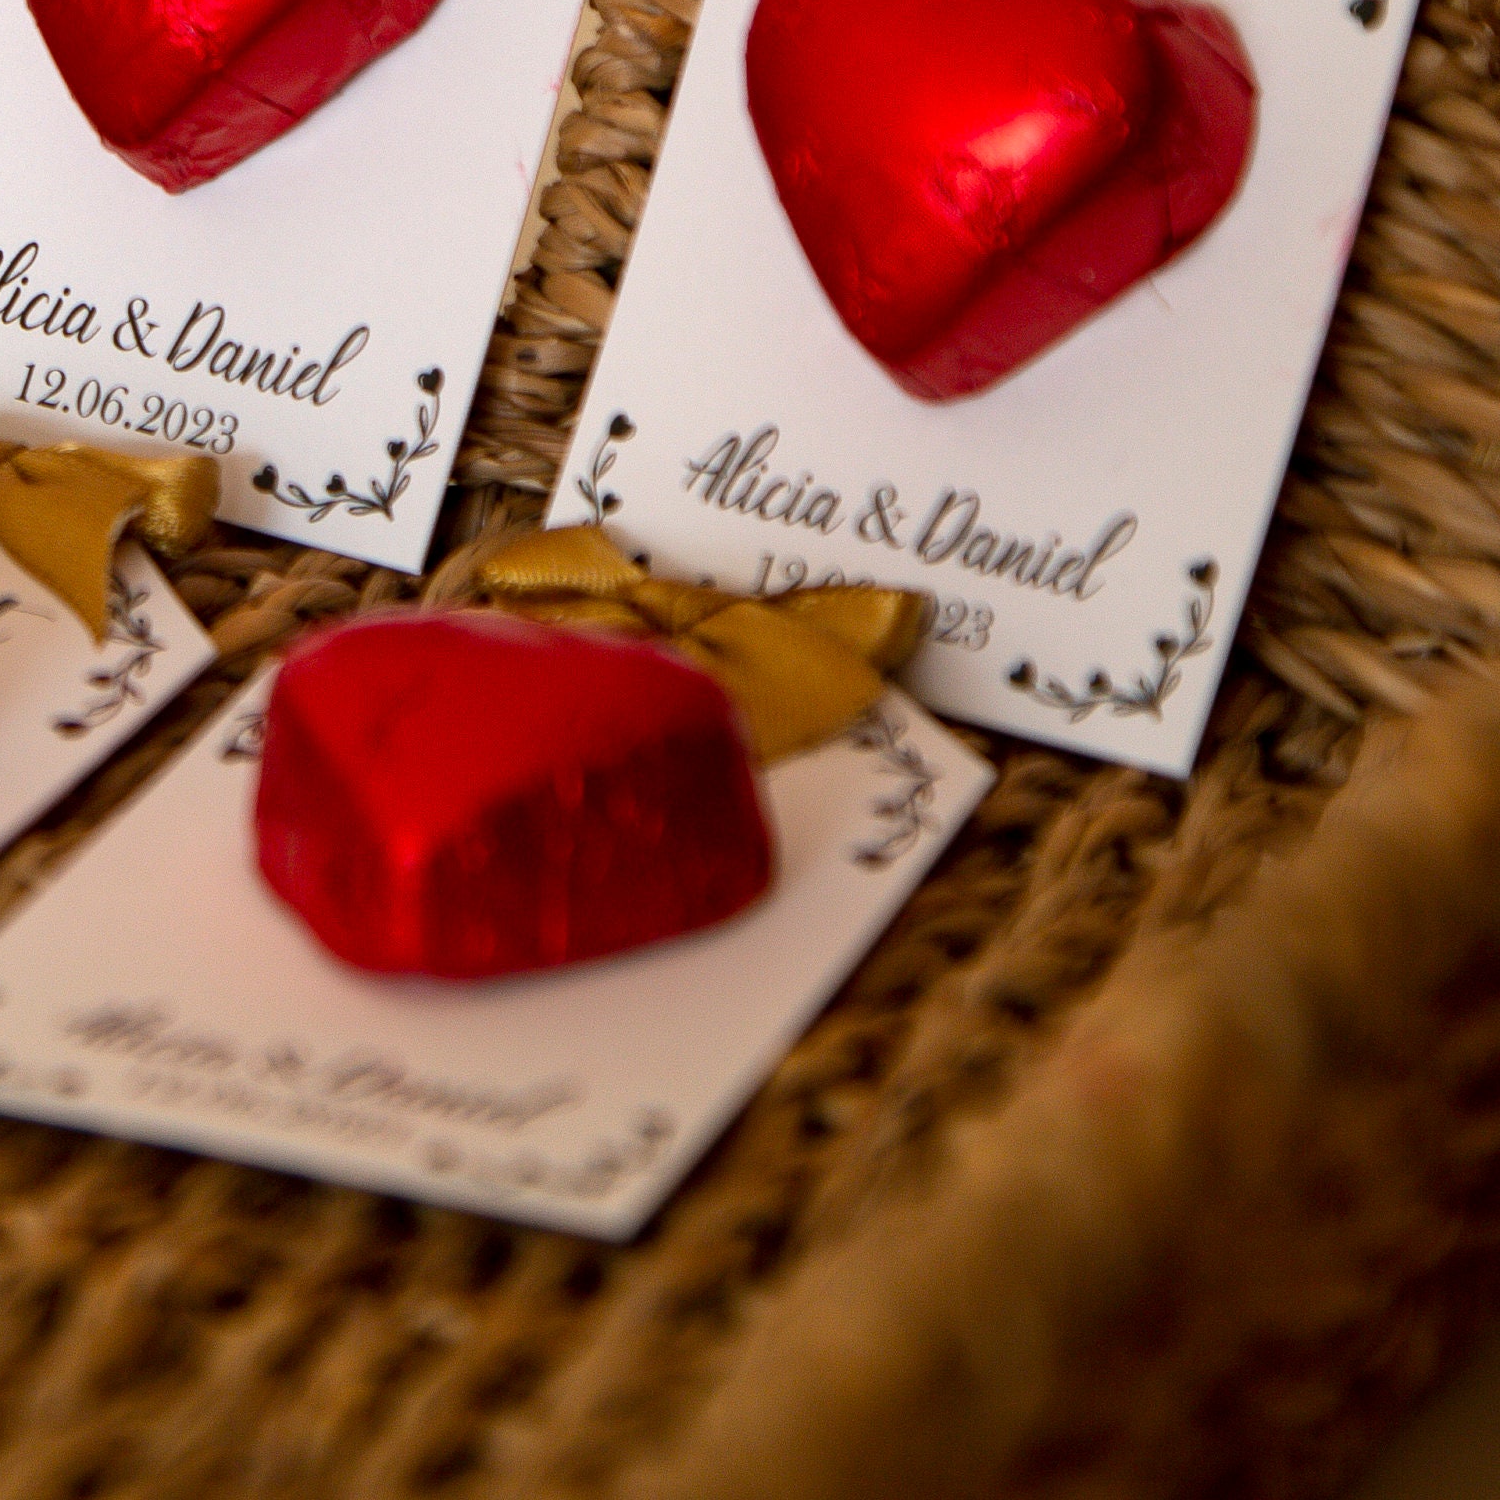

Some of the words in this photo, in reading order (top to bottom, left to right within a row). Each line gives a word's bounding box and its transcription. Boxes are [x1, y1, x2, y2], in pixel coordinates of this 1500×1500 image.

[112, 297, 160, 358] &
[166, 301, 370, 405] Daniel
[14, 363, 240, 454] 12.06.2023
[683, 425, 845, 536] Alicia
[856, 483, 908, 550] &
[914, 486, 1139, 602] Daniel
